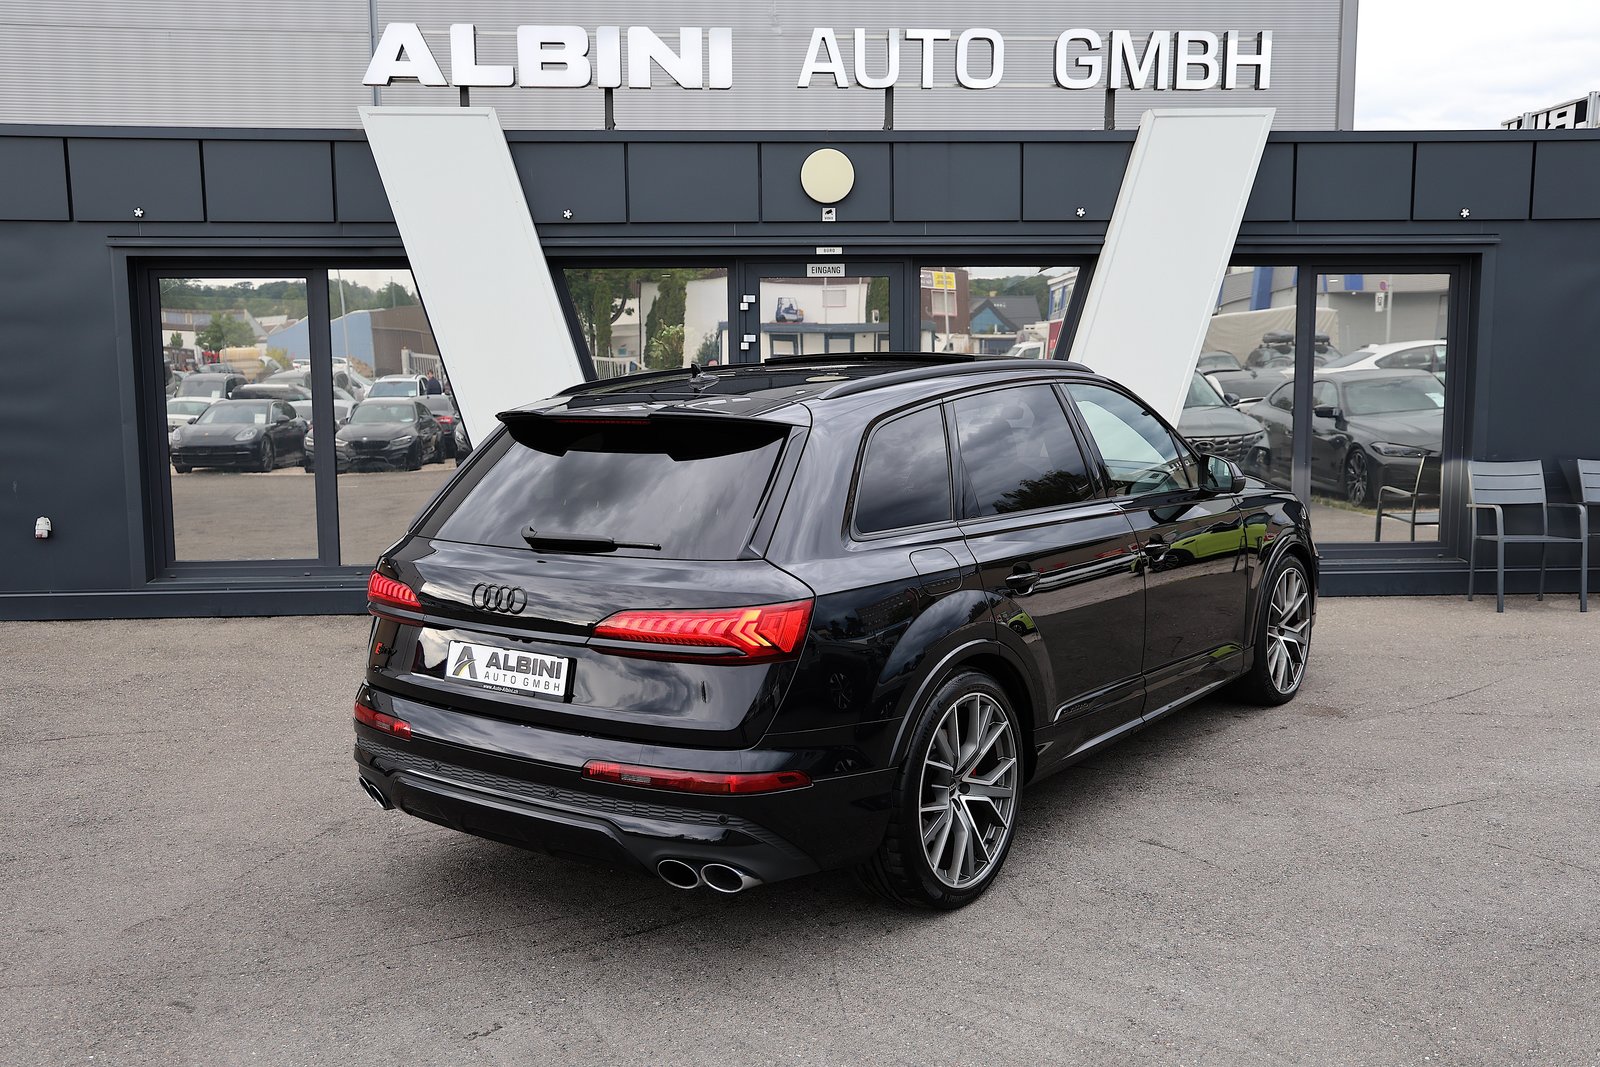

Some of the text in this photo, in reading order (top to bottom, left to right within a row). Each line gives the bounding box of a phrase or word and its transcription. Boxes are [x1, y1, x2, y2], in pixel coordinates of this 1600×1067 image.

[362, 22, 1273, 91] ALBINI AUTO GMBH
[811, 266, 841, 274] EINGANG
[485, 651, 563, 680] ALBINI
[484, 670, 561, 692] AUTO GMBH
